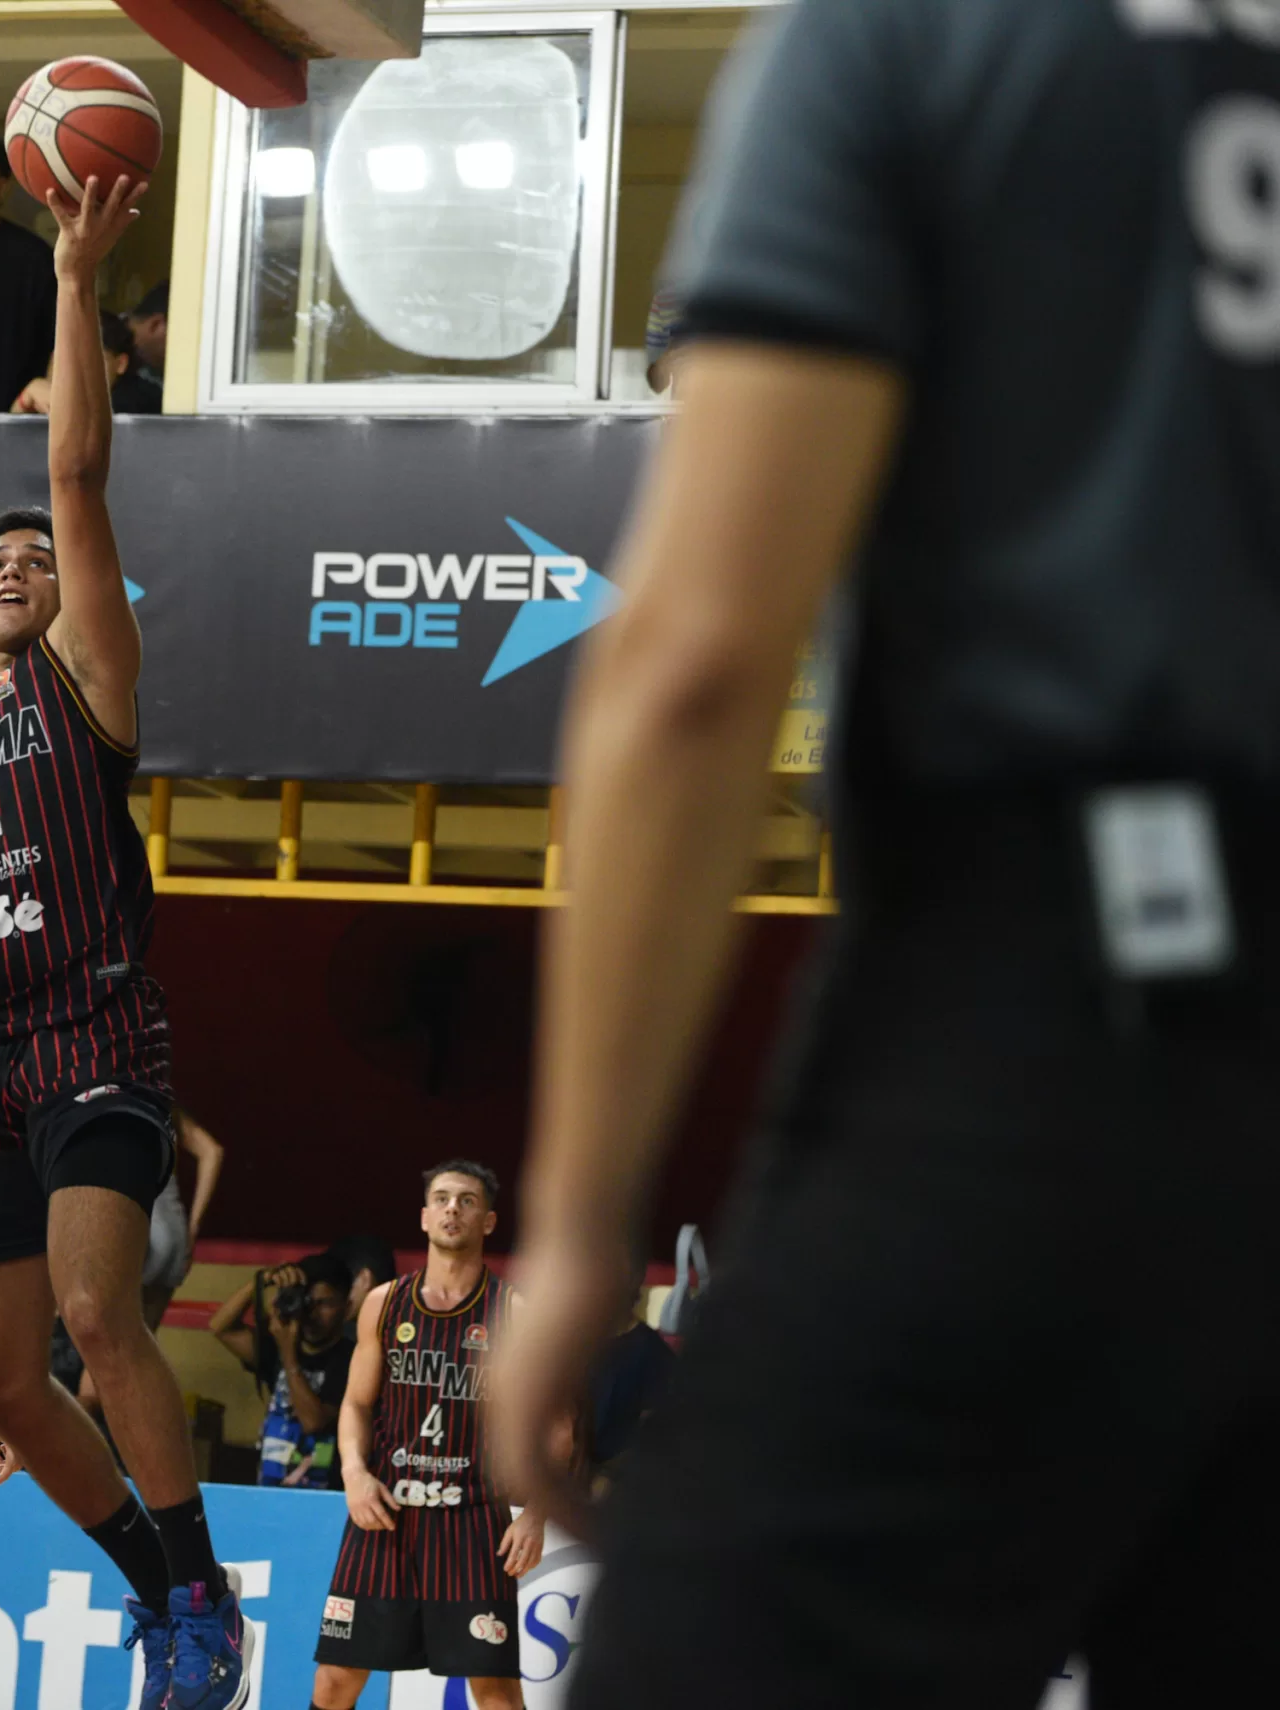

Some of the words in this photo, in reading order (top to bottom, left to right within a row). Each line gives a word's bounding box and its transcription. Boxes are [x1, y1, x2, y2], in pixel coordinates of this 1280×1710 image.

[311, 552, 588, 602] POWER
[309, 602, 461, 648] ADE
[420, 1403, 445, 1447] 4
